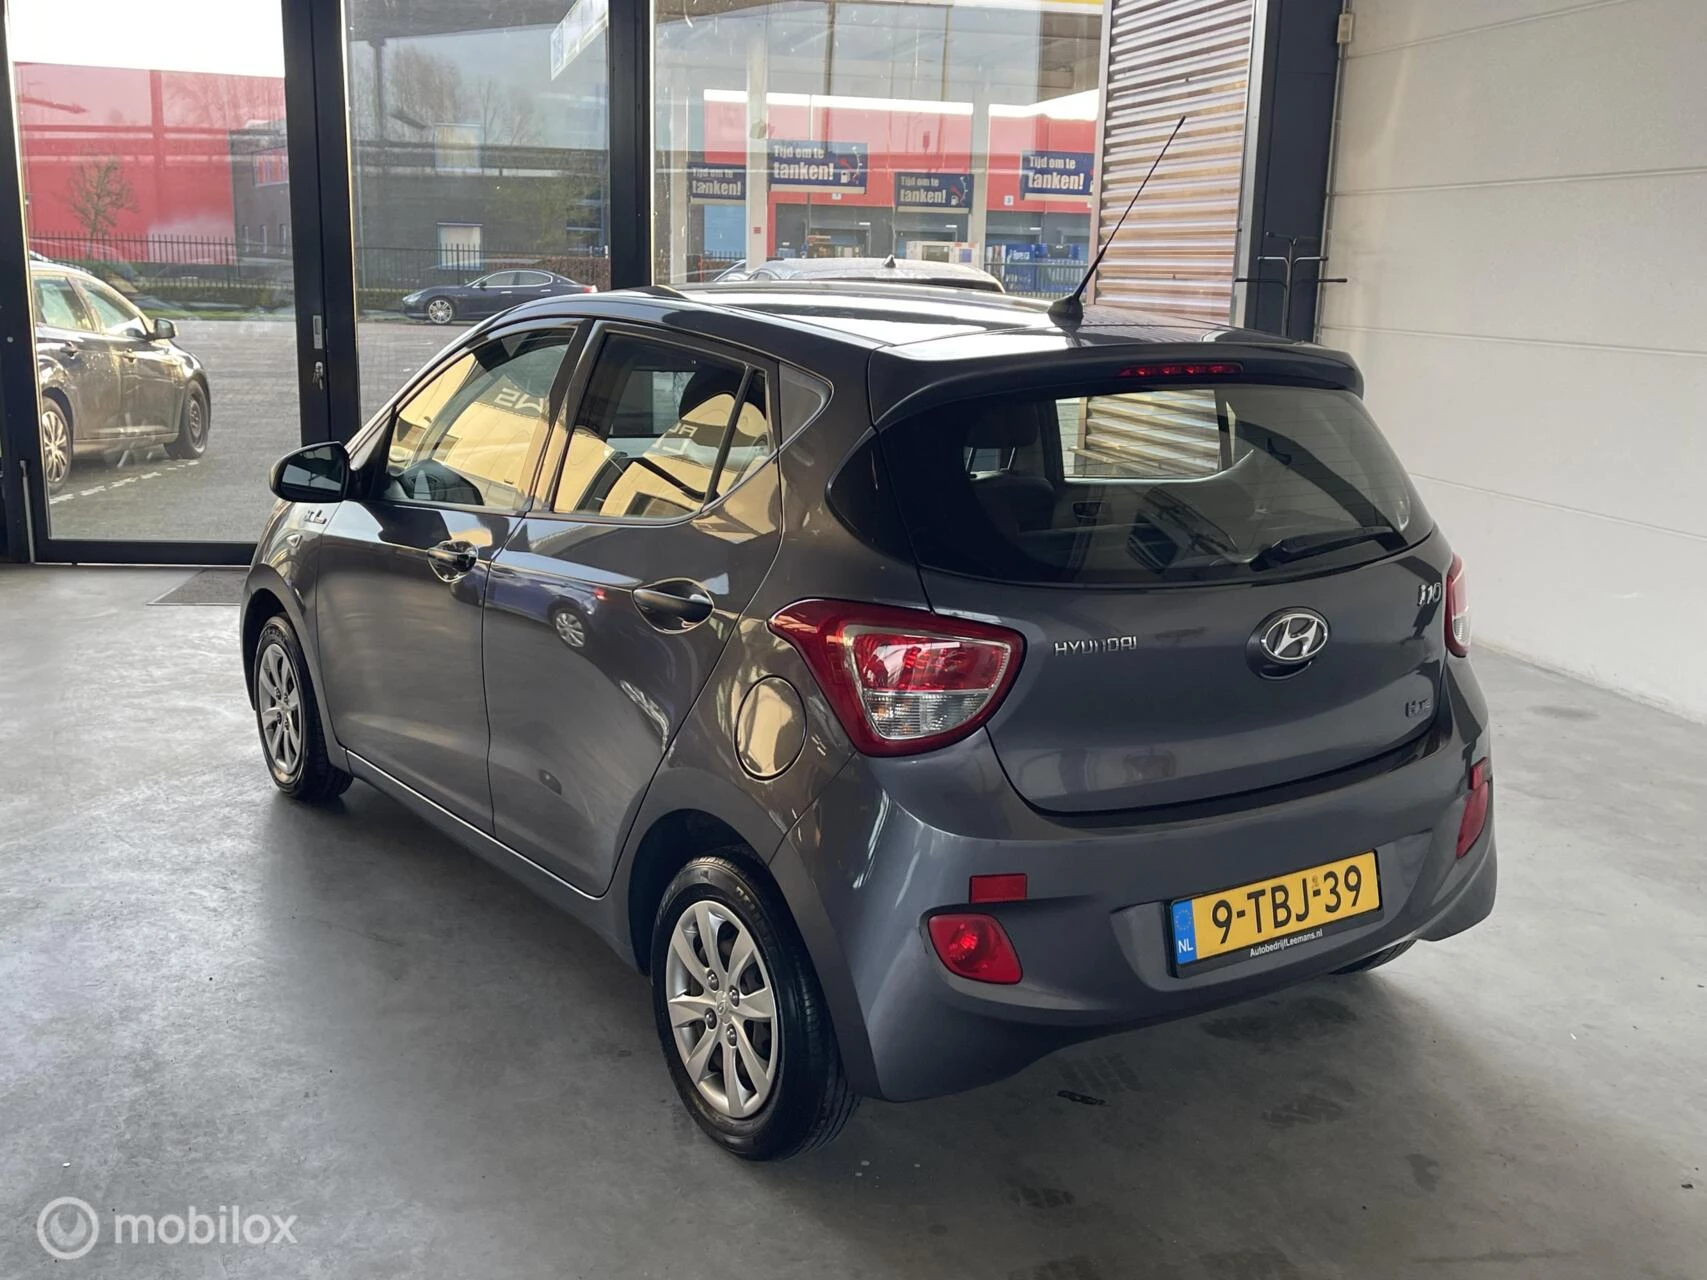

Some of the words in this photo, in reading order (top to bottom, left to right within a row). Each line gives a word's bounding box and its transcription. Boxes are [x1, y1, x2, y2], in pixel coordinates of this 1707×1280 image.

[773, 145, 793, 159] Tijd
[795, 147, 812, 159] om
[812, 147, 825, 159] te
[1029, 156, 1048, 168] Tijd
[1049, 157, 1064, 168] om
[1065, 157, 1076, 169] te
[710, 169, 723, 178] om
[724, 169, 734, 178] te
[773, 162, 834, 181] tanken!
[692, 181, 741, 196] tanken!
[900, 176, 916, 187] Tijd
[917, 177, 930, 187] om
[930, 177, 940, 187] te
[1028, 172, 1084, 190] tanken!
[900, 189, 946, 204] tanken!
[1418, 582, 1442, 606] i10
[1054, 635, 1137, 657] HYUNDAI
[1212, 865, 1362, 944] 9-TBJ-39
[1178, 937, 1194, 954] NL
